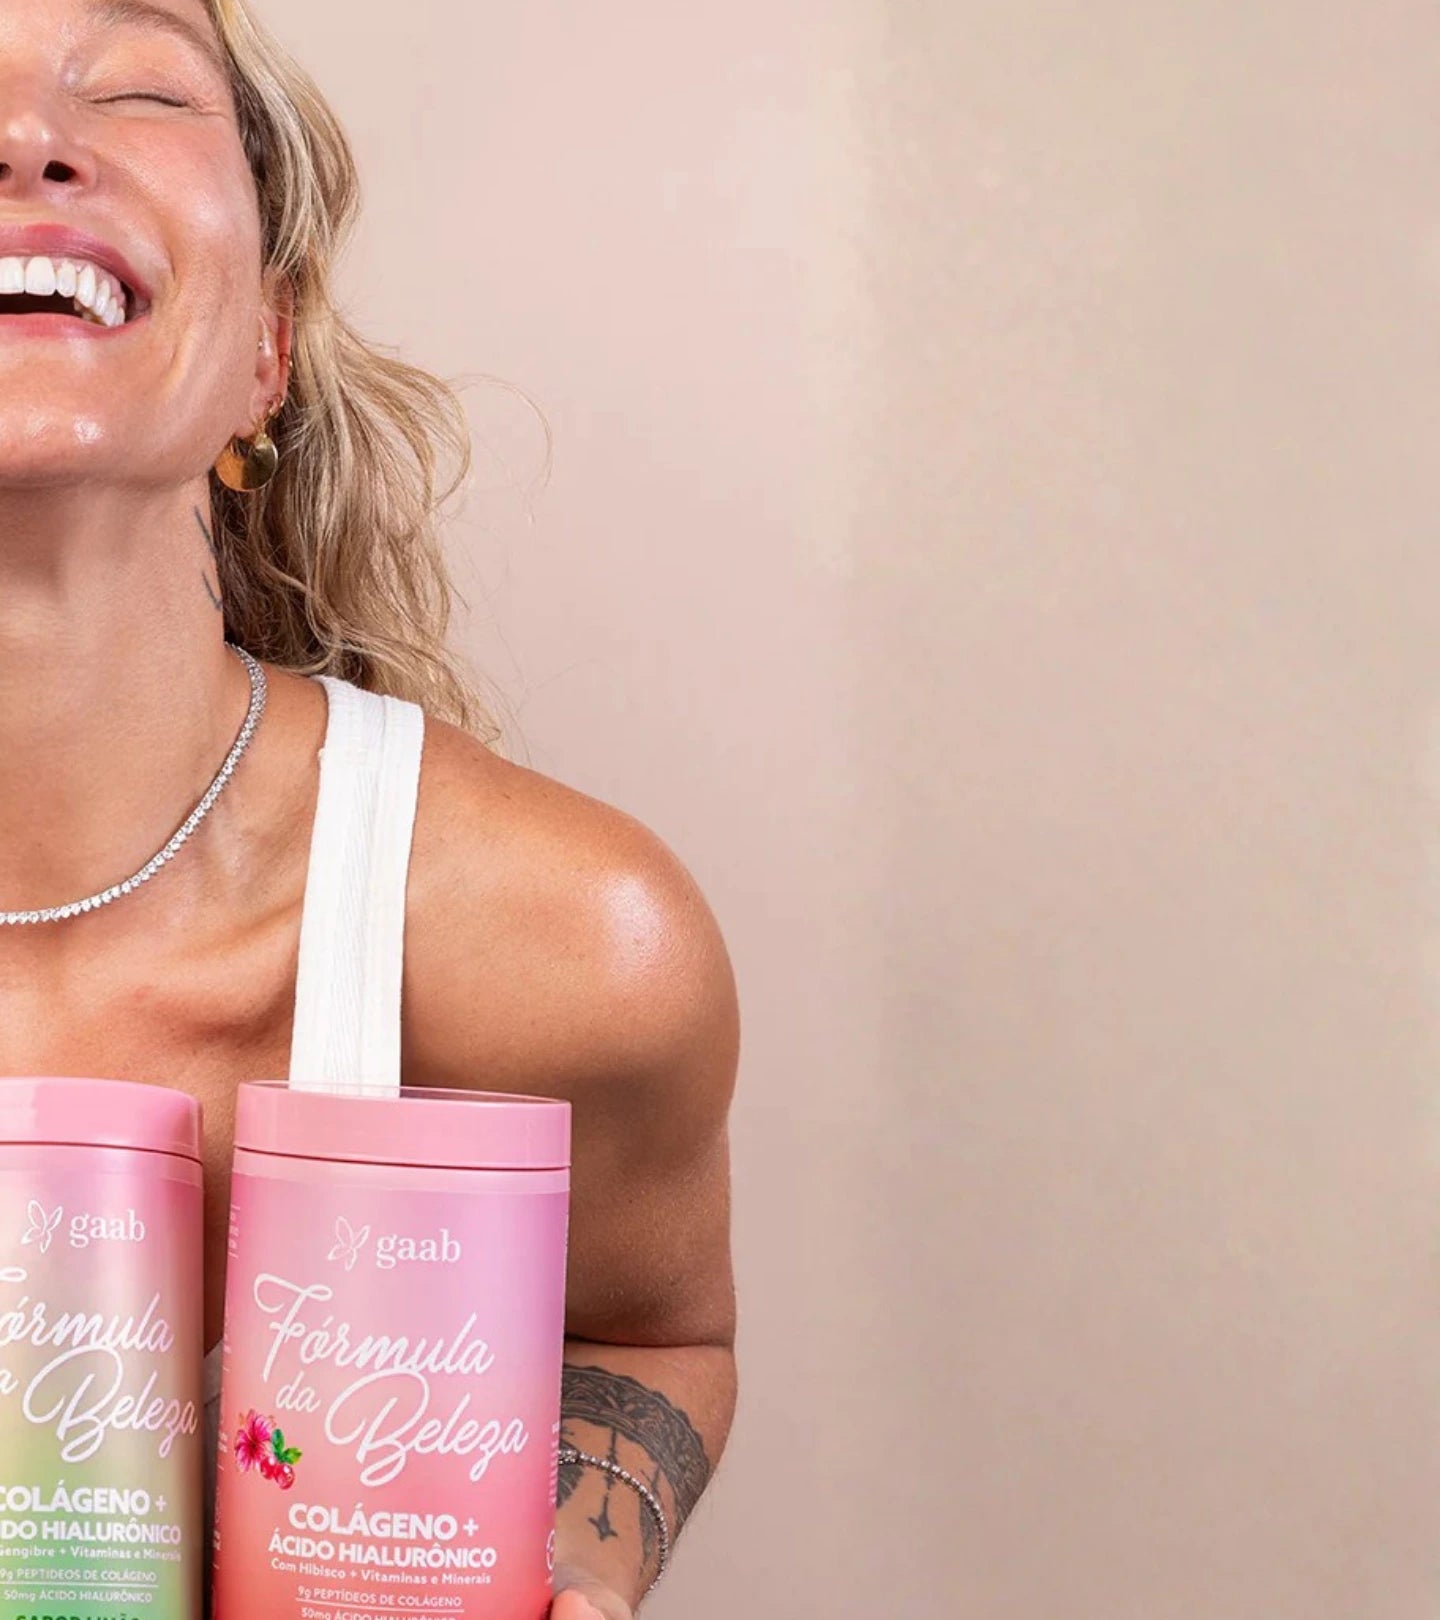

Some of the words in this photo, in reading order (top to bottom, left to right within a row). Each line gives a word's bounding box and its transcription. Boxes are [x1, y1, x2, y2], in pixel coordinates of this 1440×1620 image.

[68, 1208, 146, 1248] gaab
[375, 1228, 461, 1269] gaab
[253, 1273, 495, 1382] Fórmula
[22, 1347, 198, 1464] Beleza
[275, 1371, 321, 1413] da
[324, 1368, 529, 1487] Beleza
[155, 1495, 168, 1512] +
[42, 1517, 182, 1546] HIALURÔNICO
[288, 1503, 458, 1541] COLÁGENO
[463, 1518, 479, 1537] +
[70, 1546, 131, 1559] Vitaminas
[268, 1528, 334, 1560] ÁCIDO
[338, 1540, 497, 1569] HIALURÔNICO
[83, 1569, 98, 1581] DE
[101, 1568, 157, 1582] COLÁGENO
[271, 1557, 296, 1571] Com
[299, 1563, 347, 1580] Hibisco
[361, 1569, 428, 1584] Vitaminas
[430, 1577, 439, 1585] e
[442, 1572, 491, 1585] Minerais
[39, 1588, 77, 1601] ÁCIDO
[297, 1585, 312, 1599] 9g
[379, 1594, 395, 1606] DE
[397, 1594, 462, 1607] COLÁGENO
